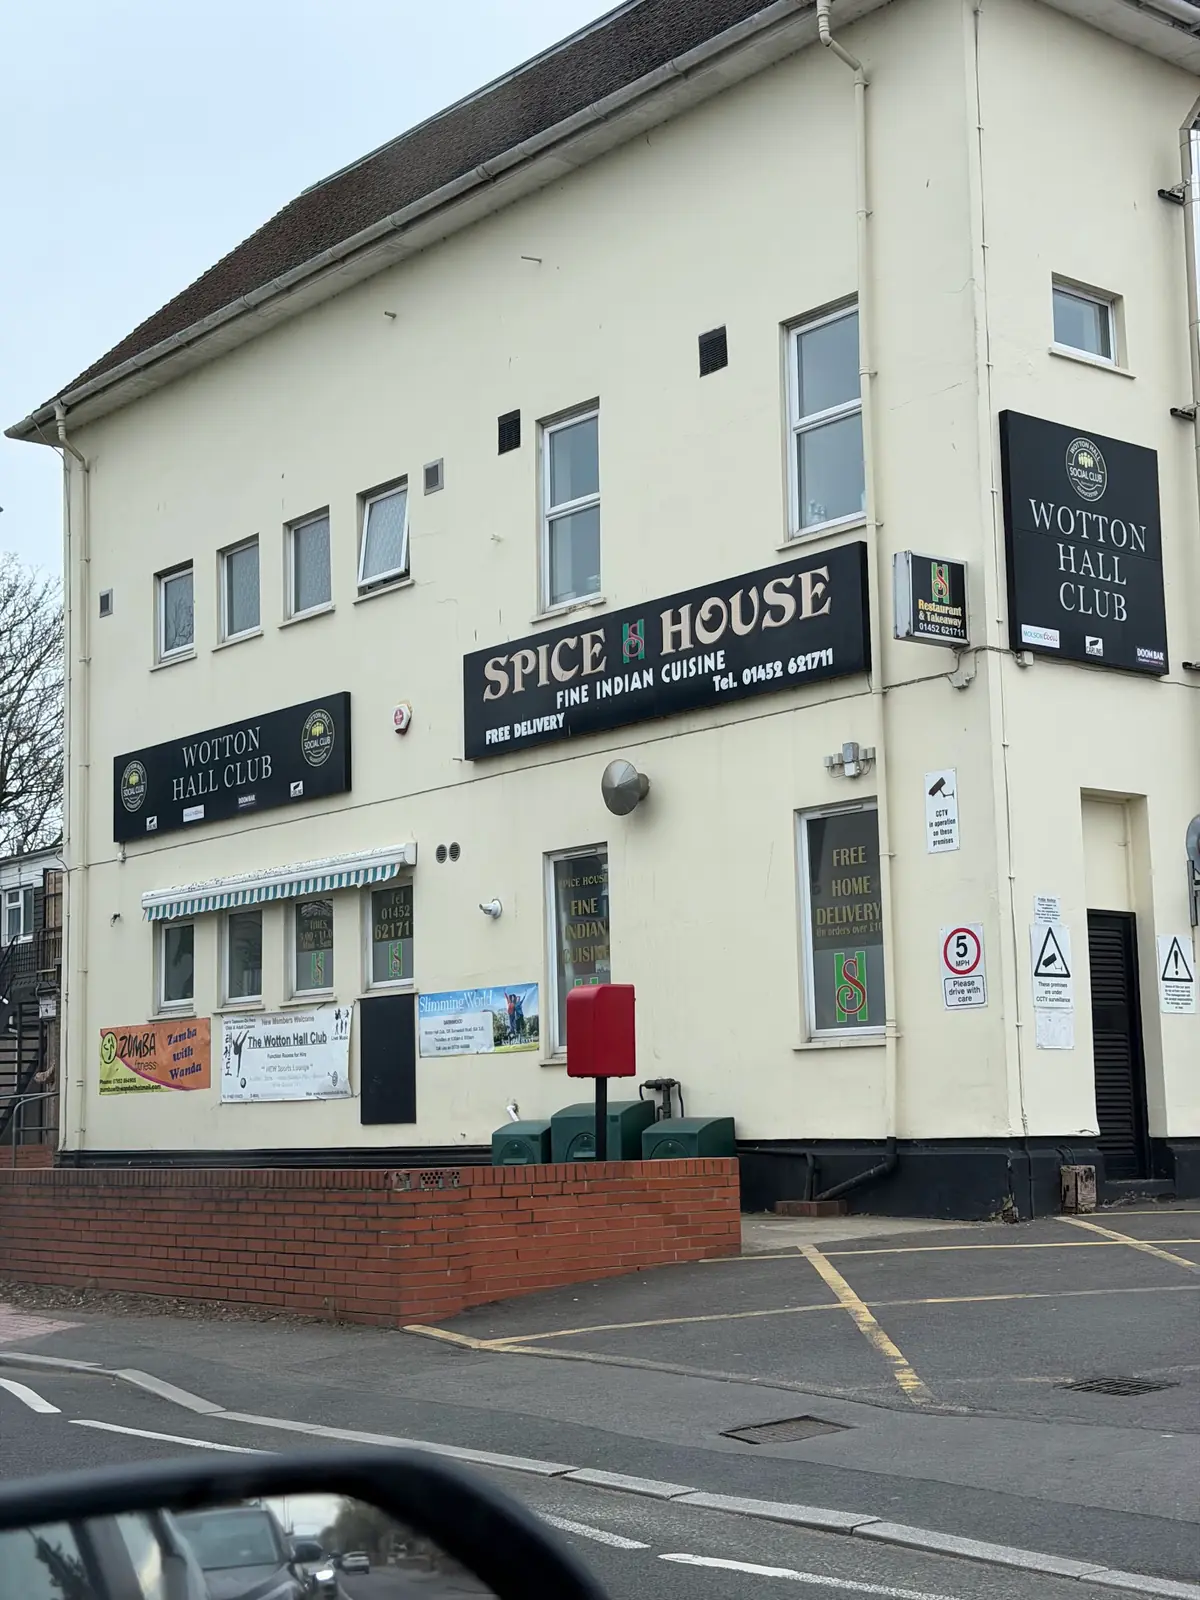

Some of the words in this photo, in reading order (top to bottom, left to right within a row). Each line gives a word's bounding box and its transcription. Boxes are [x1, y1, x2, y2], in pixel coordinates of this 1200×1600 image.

[1070, 441, 1089, 454] WOTTON
[1090, 445, 1102, 462] HALL
[1069, 467, 1089, 480] SOCIAL
[1089, 472, 1103, 483] CLUB
[1029, 498, 1147, 552] WOTTON
[1057, 543, 1127, 585] HALL
[918, 599, 962, 616] Restaurant
[1059, 581, 1128, 622] CLUB
[659, 565, 832, 657] HOUSE
[918, 611, 925, 620] &
[926, 611, 962, 628] Takeaway
[919, 622, 940, 633] 01452
[941, 626, 965, 637] 621711
[1136, 648, 1153, 658] DOOM
[1154, 650, 1164, 661] BAR
[483, 628, 607, 701] SPICE
[713, 671, 737, 692] Tel.
[742, 659, 784, 686] 01452
[787, 647, 834, 677] 621711
[556, 684, 589, 710] FINE
[596, 668, 654, 700] INDIAN
[661, 650, 726, 684] CUISINE
[485, 724, 511, 745] FREE
[513, 712, 565, 740] DELIVERY
[182, 726, 261, 769] WOTTON
[304, 739, 319, 750] SOCIAL
[320, 736, 331, 747] CLUB
[172, 769, 218, 802] HALL
[224, 755, 272, 788] CLUB
[936, 809, 948, 817] CCTV
[934, 818, 956, 827] operation
[933, 838, 953, 846] premises
[832, 846, 866, 867] FREE
[831, 876, 871, 897] HOME
[382, 905, 410, 919] 01452
[570, 898, 598, 916] FINE
[816, 902, 881, 926] DELIVERY
[828, 926, 850, 936] orders
[852, 924, 867, 934] over
[956, 935, 968, 958] 5
[948, 987, 965, 996] drive
[966, 986, 981, 994] with
[119, 1032, 156, 1059] ZUMBA
[167, 1028, 197, 1046] Zumba
[248, 1036, 262, 1048] The
[264, 1035, 291, 1047] Wotton
[293, 1032, 308, 1045] Hall
[310, 1031, 327, 1044] Club
[172, 1046, 193, 1061] with
[169, 1062, 202, 1080] Wanda
